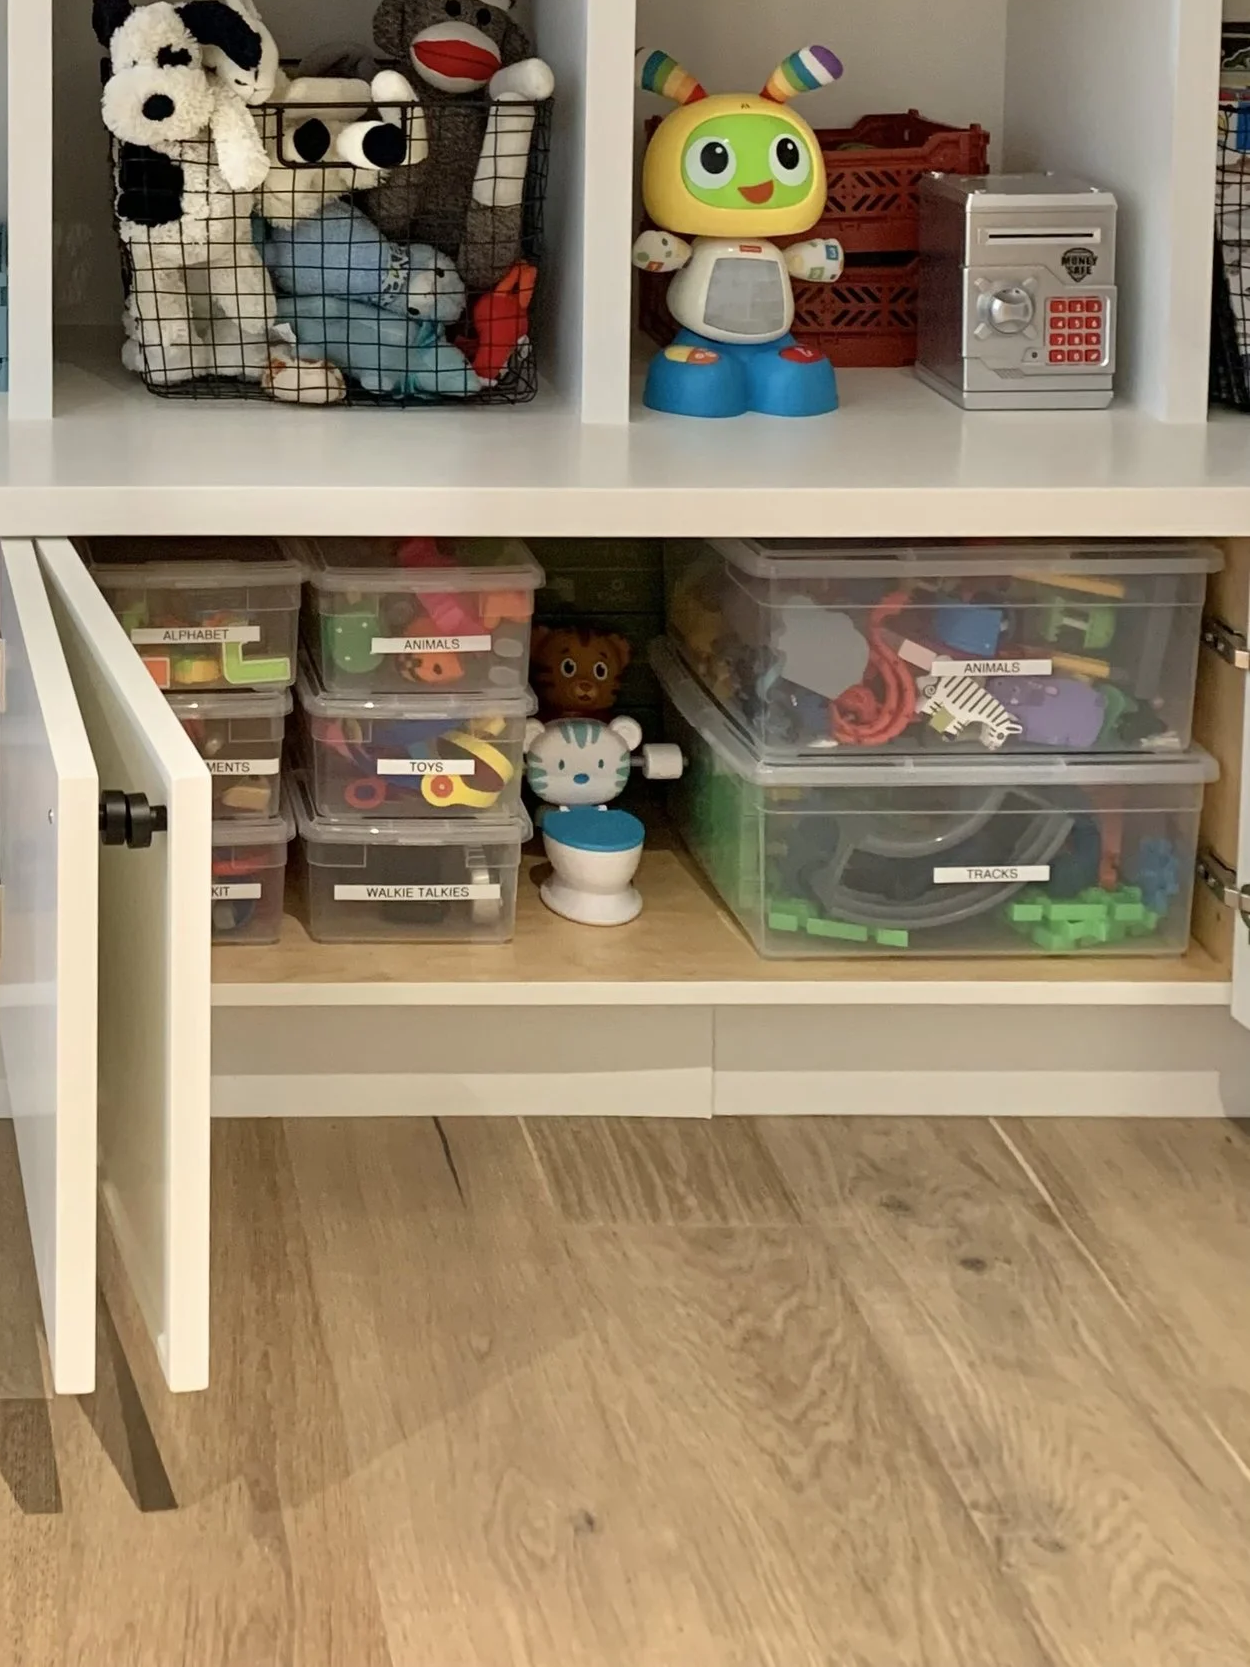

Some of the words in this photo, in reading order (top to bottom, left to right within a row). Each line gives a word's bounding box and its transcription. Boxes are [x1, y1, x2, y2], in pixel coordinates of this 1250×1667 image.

[1061, 256, 1098, 266] MONEY
[1067, 265, 1092, 275] SAFE
[162, 627, 231, 641] ALPHABET
[403, 637, 461, 651] ANIMALS
[963, 661, 1021, 675] ANIMALS
[205, 761, 251, 774] MENTS
[409, 760, 445, 773] TOYS
[966, 867, 1020, 881] TRACKS
[366, 885, 414, 899] WALKIE
[416, 885, 470, 899] TALKIES
